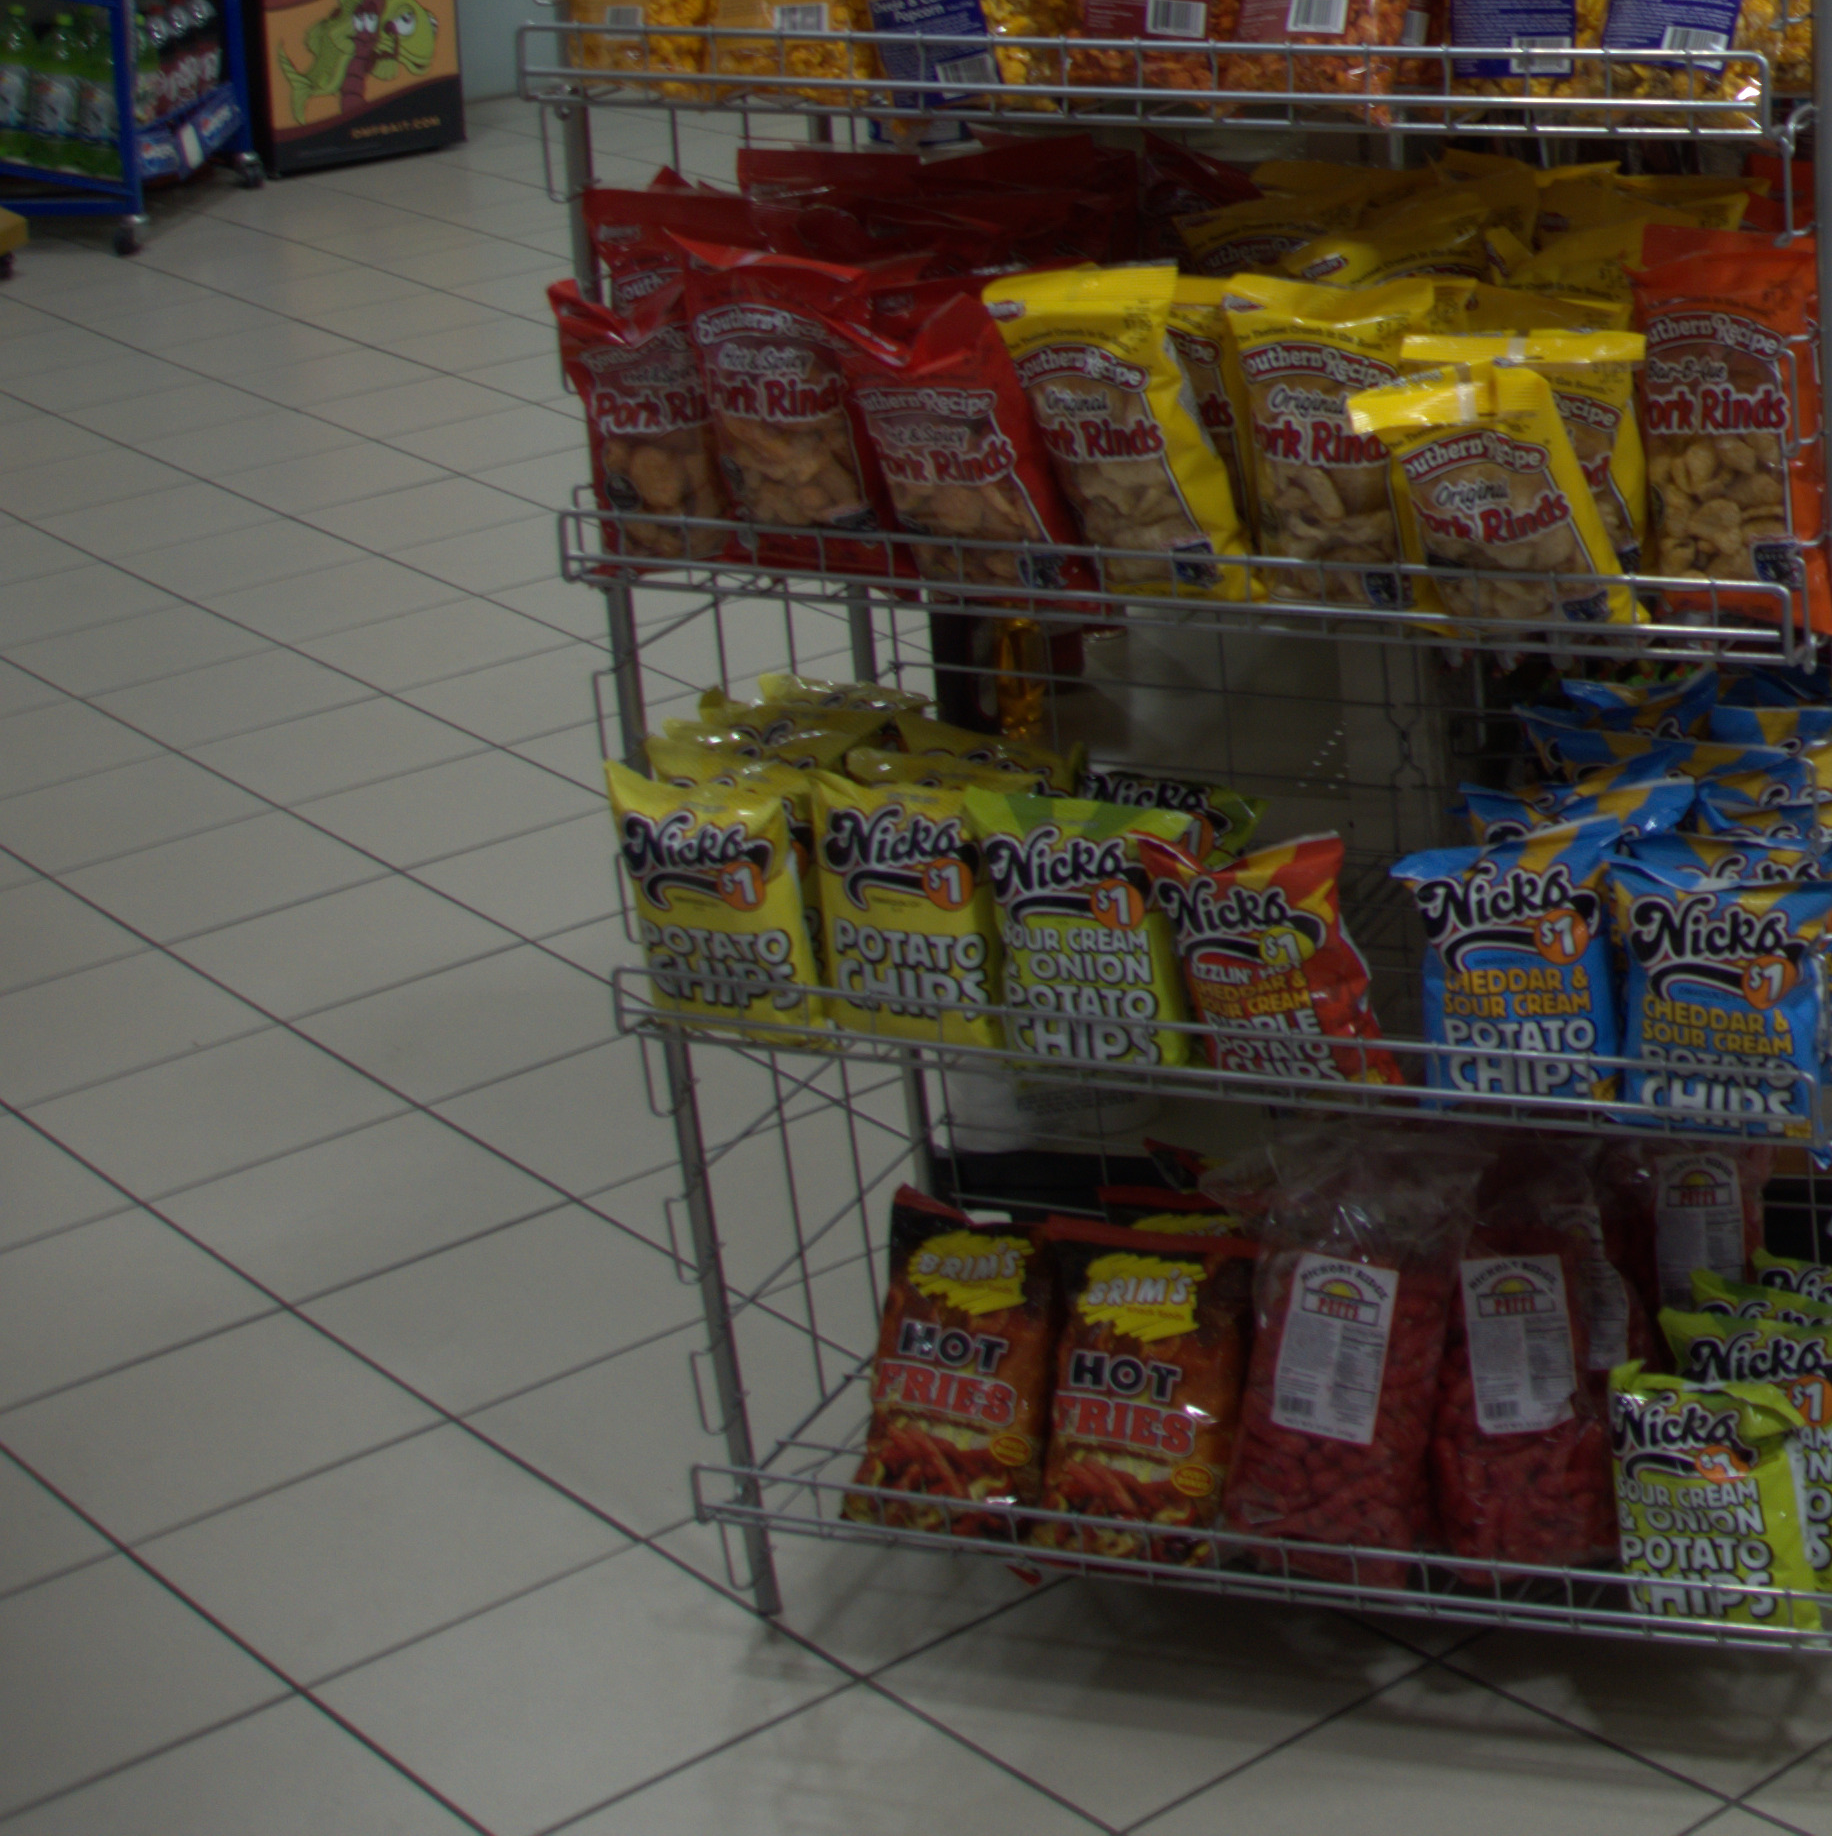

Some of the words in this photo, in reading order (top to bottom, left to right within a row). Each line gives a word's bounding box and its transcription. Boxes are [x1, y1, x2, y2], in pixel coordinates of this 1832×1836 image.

[1712, 314, 1777, 355] Recipe
[1084, 347, 1142, 386] Recipe
[921, 390, 995, 415] Recipe
[1045, 387, 1109, 414] Original
[1701, 388, 1789, 431] Rinds
[1082, 418, 1164, 458] Rinds
[932, 441, 1014, 484] Rinds
[1482, 495, 1570, 543] Rinds
[724, 867, 757, 906] $1
[930, 864, 965, 903] $1
[1096, 884, 1134, 925] $1
[641, 919, 790, 963] POTATO
[835, 918, 986, 971] POTATO
[1080, 929, 1149, 954] CREAM
[1540, 915, 1578, 956] $1
[1029, 954, 1152, 984] ONION
[1444, 969, 1565, 993] CHEDDAR
[1574, 966, 1588, 989] &
[1749, 962, 1786, 1002] $1
[838, 967, 988, 1019] CHIPS
[1007, 986, 1158, 1020] POTATO
[1442, 993, 1509, 1016] SOUR
[1515, 990, 1592, 1015] CREAM
[1444, 1016, 1595, 1052] POTATO
[1642, 998, 1768, 1033] CHEDDAR
[1774, 1008, 1789, 1032] &
[1642, 1019, 1709, 1049] SOUR
[1715, 1024, 1794, 1054] CREAM
[1449, 1053, 1598, 1099] CHIPS
[1086, 1271, 1194, 1307] BRIM'S
[900, 1320, 1007, 1372] HOT
[873, 1360, 1018, 1427] FRIES
[1069, 1350, 1182, 1401] HOT
[1055, 1394, 1195, 1458] FRIES
[1617, 1478, 1671, 1506] SOUR
[1676, 1478, 1758, 1507] CREAM
[1644, 1506, 1765, 1536] ONION
[1621, 1536, 1771, 1571] POTATO
